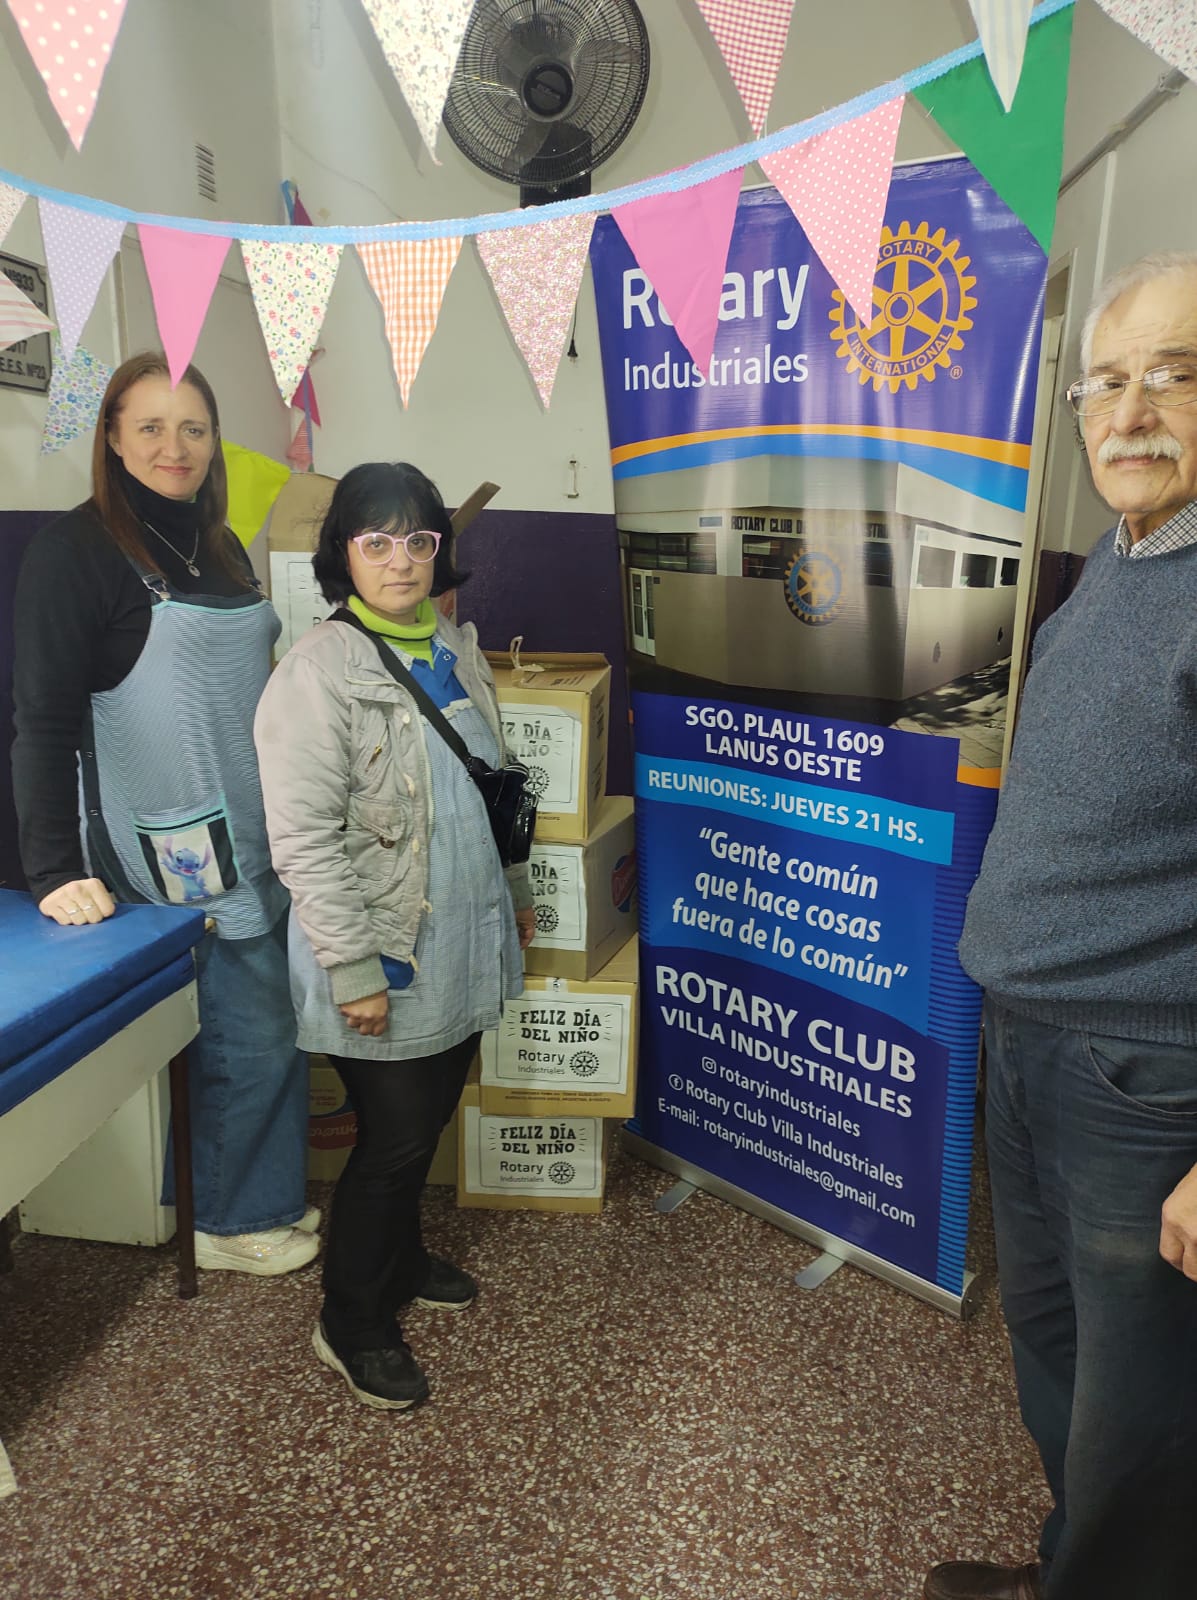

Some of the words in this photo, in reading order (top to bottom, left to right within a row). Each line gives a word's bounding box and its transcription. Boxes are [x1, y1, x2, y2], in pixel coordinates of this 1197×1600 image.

[878, 240, 935, 261] OTARY
[623, 264, 809, 330] Rary
[623, 344, 809, 391] Industriales
[850, 332, 951, 375] INTERNATIONAL
[731, 515, 766, 532] ROTARY
[770, 518, 793, 533] CLUB
[523, 720, 552, 740] DÍA
[685, 705, 738, 731] SGO.
[744, 713, 816, 747] PLAUL
[823, 728, 885, 756] 1609
[705, 733, 779, 766] LANUS
[784, 748, 862, 782] OESTE
[648, 769, 767, 808] REUNIONES:
[771, 791, 849, 825] JUEVES
[855, 809, 880, 832] 21
[888, 816, 924, 844] HS.
[531, 860, 559, 880] DÍA
[699, 827, 780, 874] “Gente
[785, 857, 878, 899] común
[695, 872, 737, 901] que
[743, 877, 800, 921] hace
[805, 904, 881, 942] cosas
[672, 897, 733, 938] fuera
[739, 918, 767, 949] de
[771, 927, 795, 958] lo
[800, 948, 908, 990] común”
[519, 1009, 566, 1026] FELIZ
[573, 1009, 601, 1027] DÍA
[521, 1027, 551, 1042] DEL
[558, 1027, 600, 1043] NIÑO
[655, 965, 798, 1039] ROTARY
[807, 1019, 916, 1083] CLUB
[518, 1049, 565, 1064] Rotary
[660, 1005, 725, 1045] VILLA
[730, 1029, 912, 1118] INDUSTRIALES
[719, 1064, 861, 1138] rotaryindustriales
[500, 1126, 543, 1140] FELIZ
[550, 1123, 576, 1140] DÍA
[502, 1142, 530, 1155] DEL
[536, 1140, 575, 1155] NIÑO
[686, 1079, 730, 1117] Rotary
[734, 1101, 767, 1128] Club
[771, 1115, 802, 1145] Villa
[807, 1133, 903, 1190] Industriales
[500, 1160, 544, 1175] Rotary
[658, 1097, 700, 1128] E-mail:
[704, 1120, 915, 1228] rotaryindustriales@gmail.com
